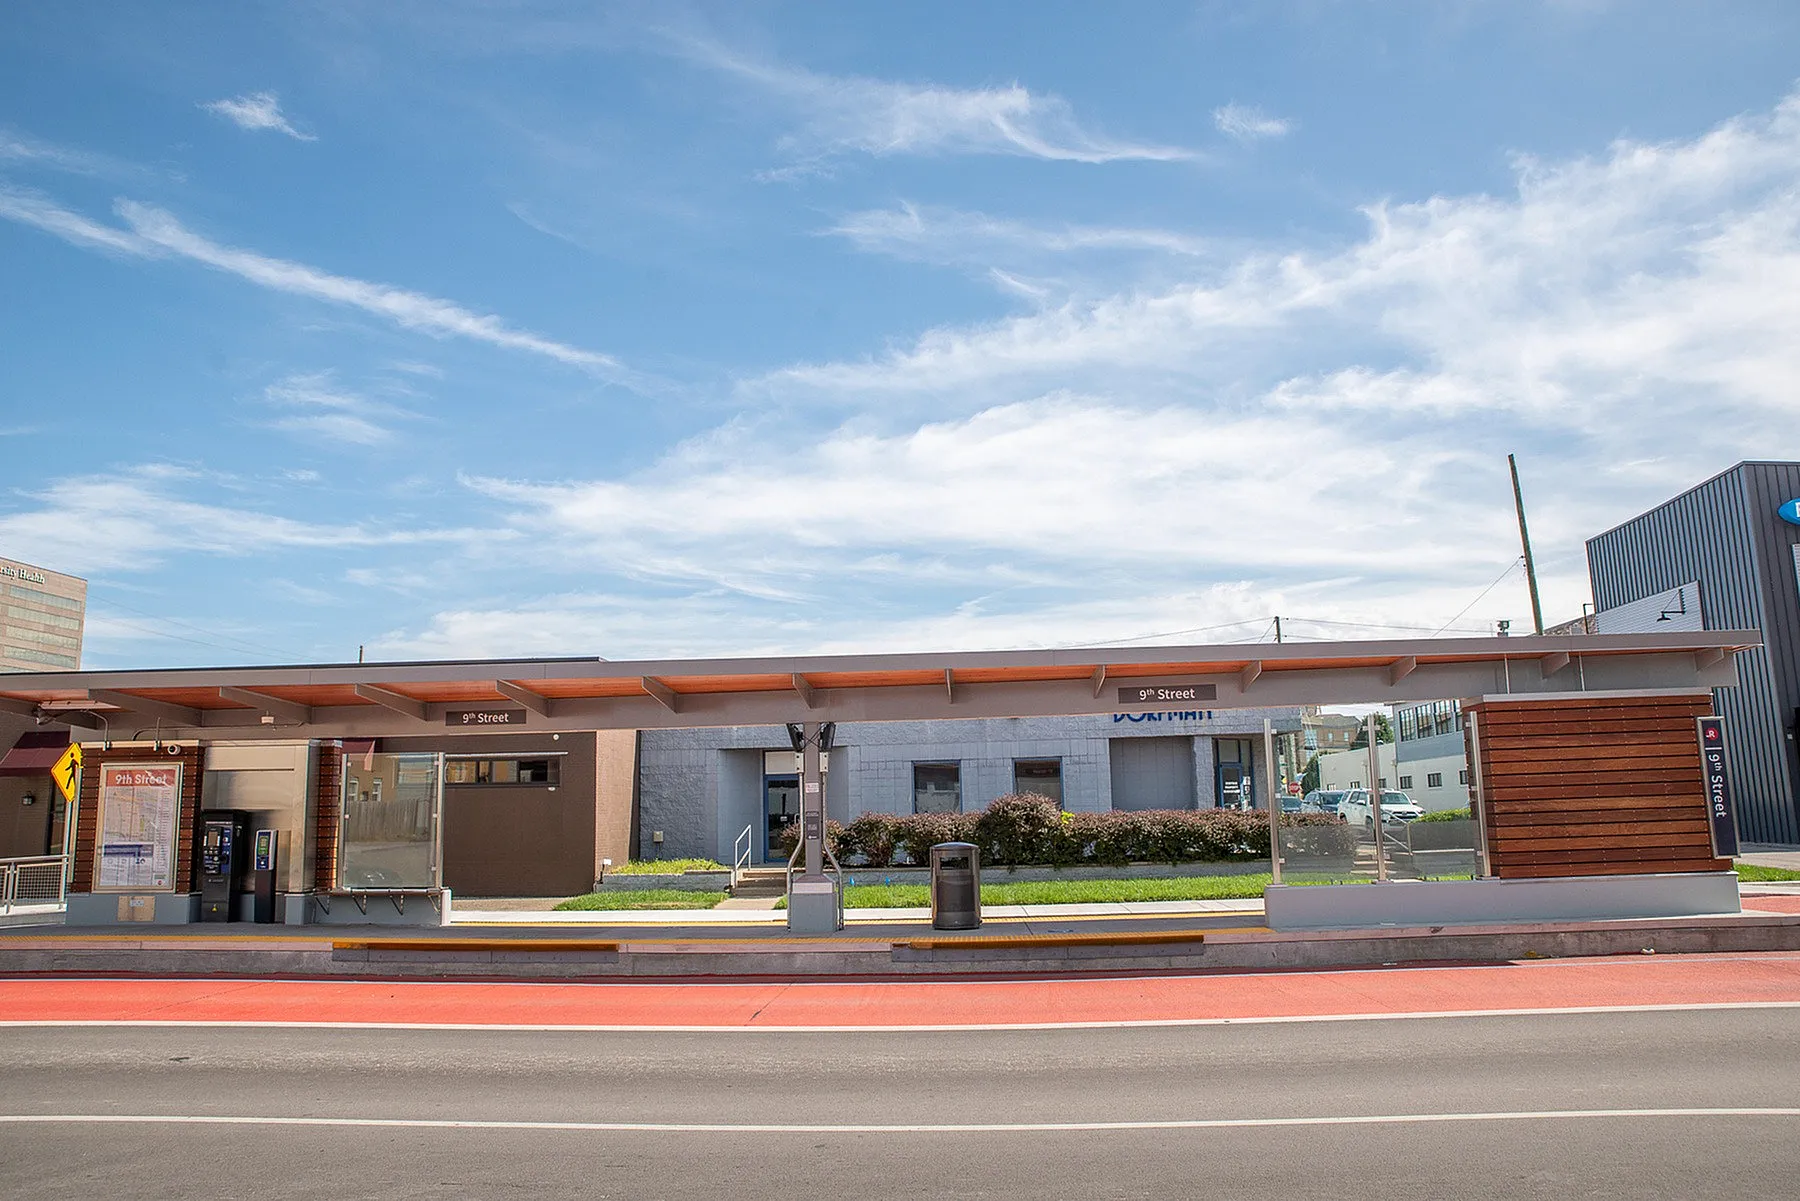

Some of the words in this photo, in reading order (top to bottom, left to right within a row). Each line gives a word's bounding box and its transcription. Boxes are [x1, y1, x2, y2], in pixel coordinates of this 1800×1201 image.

[1139, 688, 1155, 700] 9th
[1157, 688, 1195, 700] Street
[462, 713, 476, 723] 9th
[477, 713, 509, 723] Street
[1708, 754, 1722, 771] 9th
[115, 774, 133, 785] 9th
[135, 774, 167, 785] Street
[1711, 775, 1727, 818] Street
